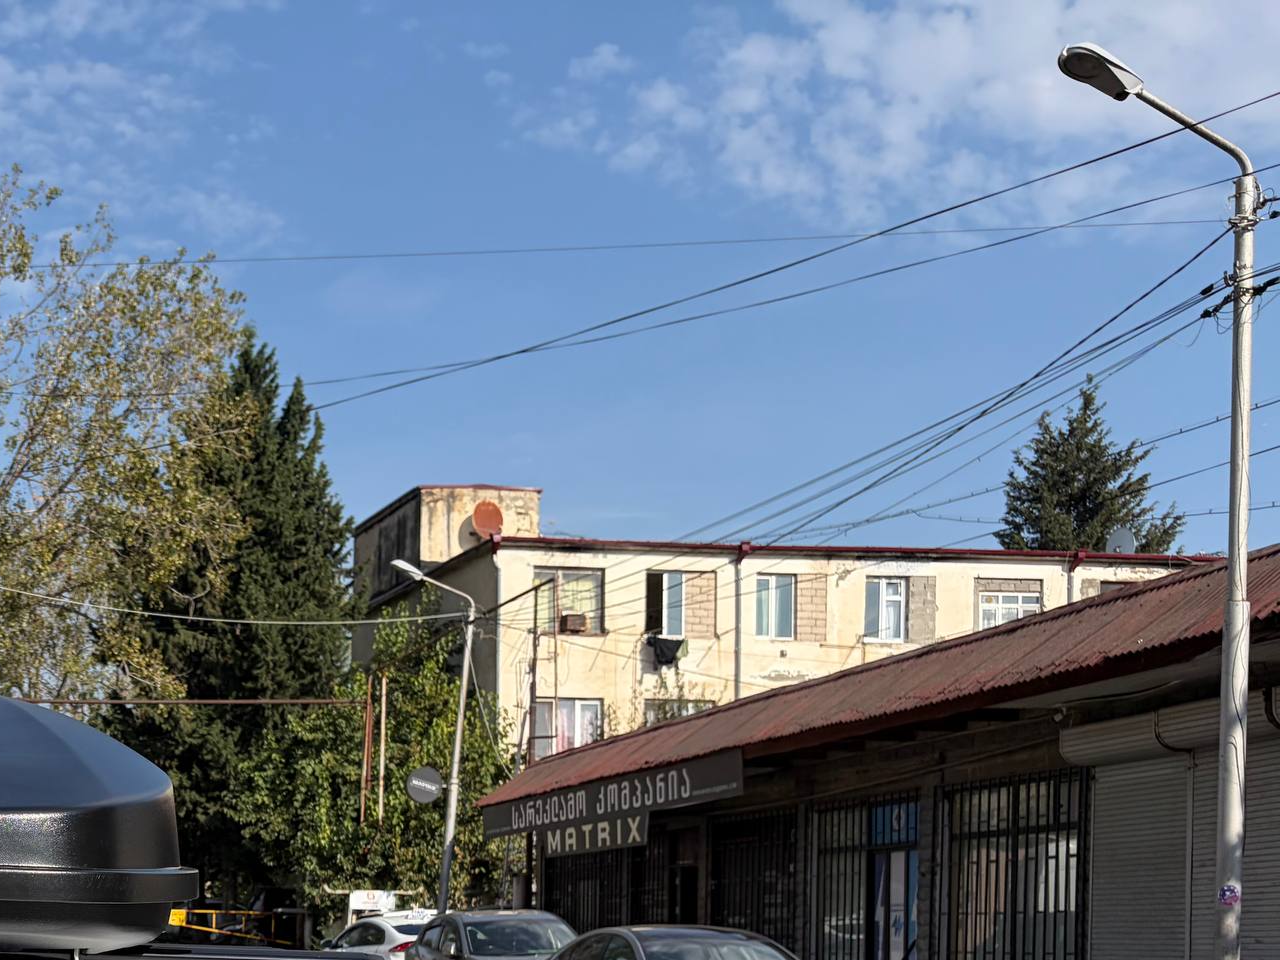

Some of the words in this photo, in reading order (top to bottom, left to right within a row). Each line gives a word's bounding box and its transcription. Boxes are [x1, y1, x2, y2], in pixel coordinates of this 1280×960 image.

[511, 790, 587, 830] სარეკლამო
[596, 767, 691, 815] კომპანია
[546, 815, 642, 855] MATRIX
